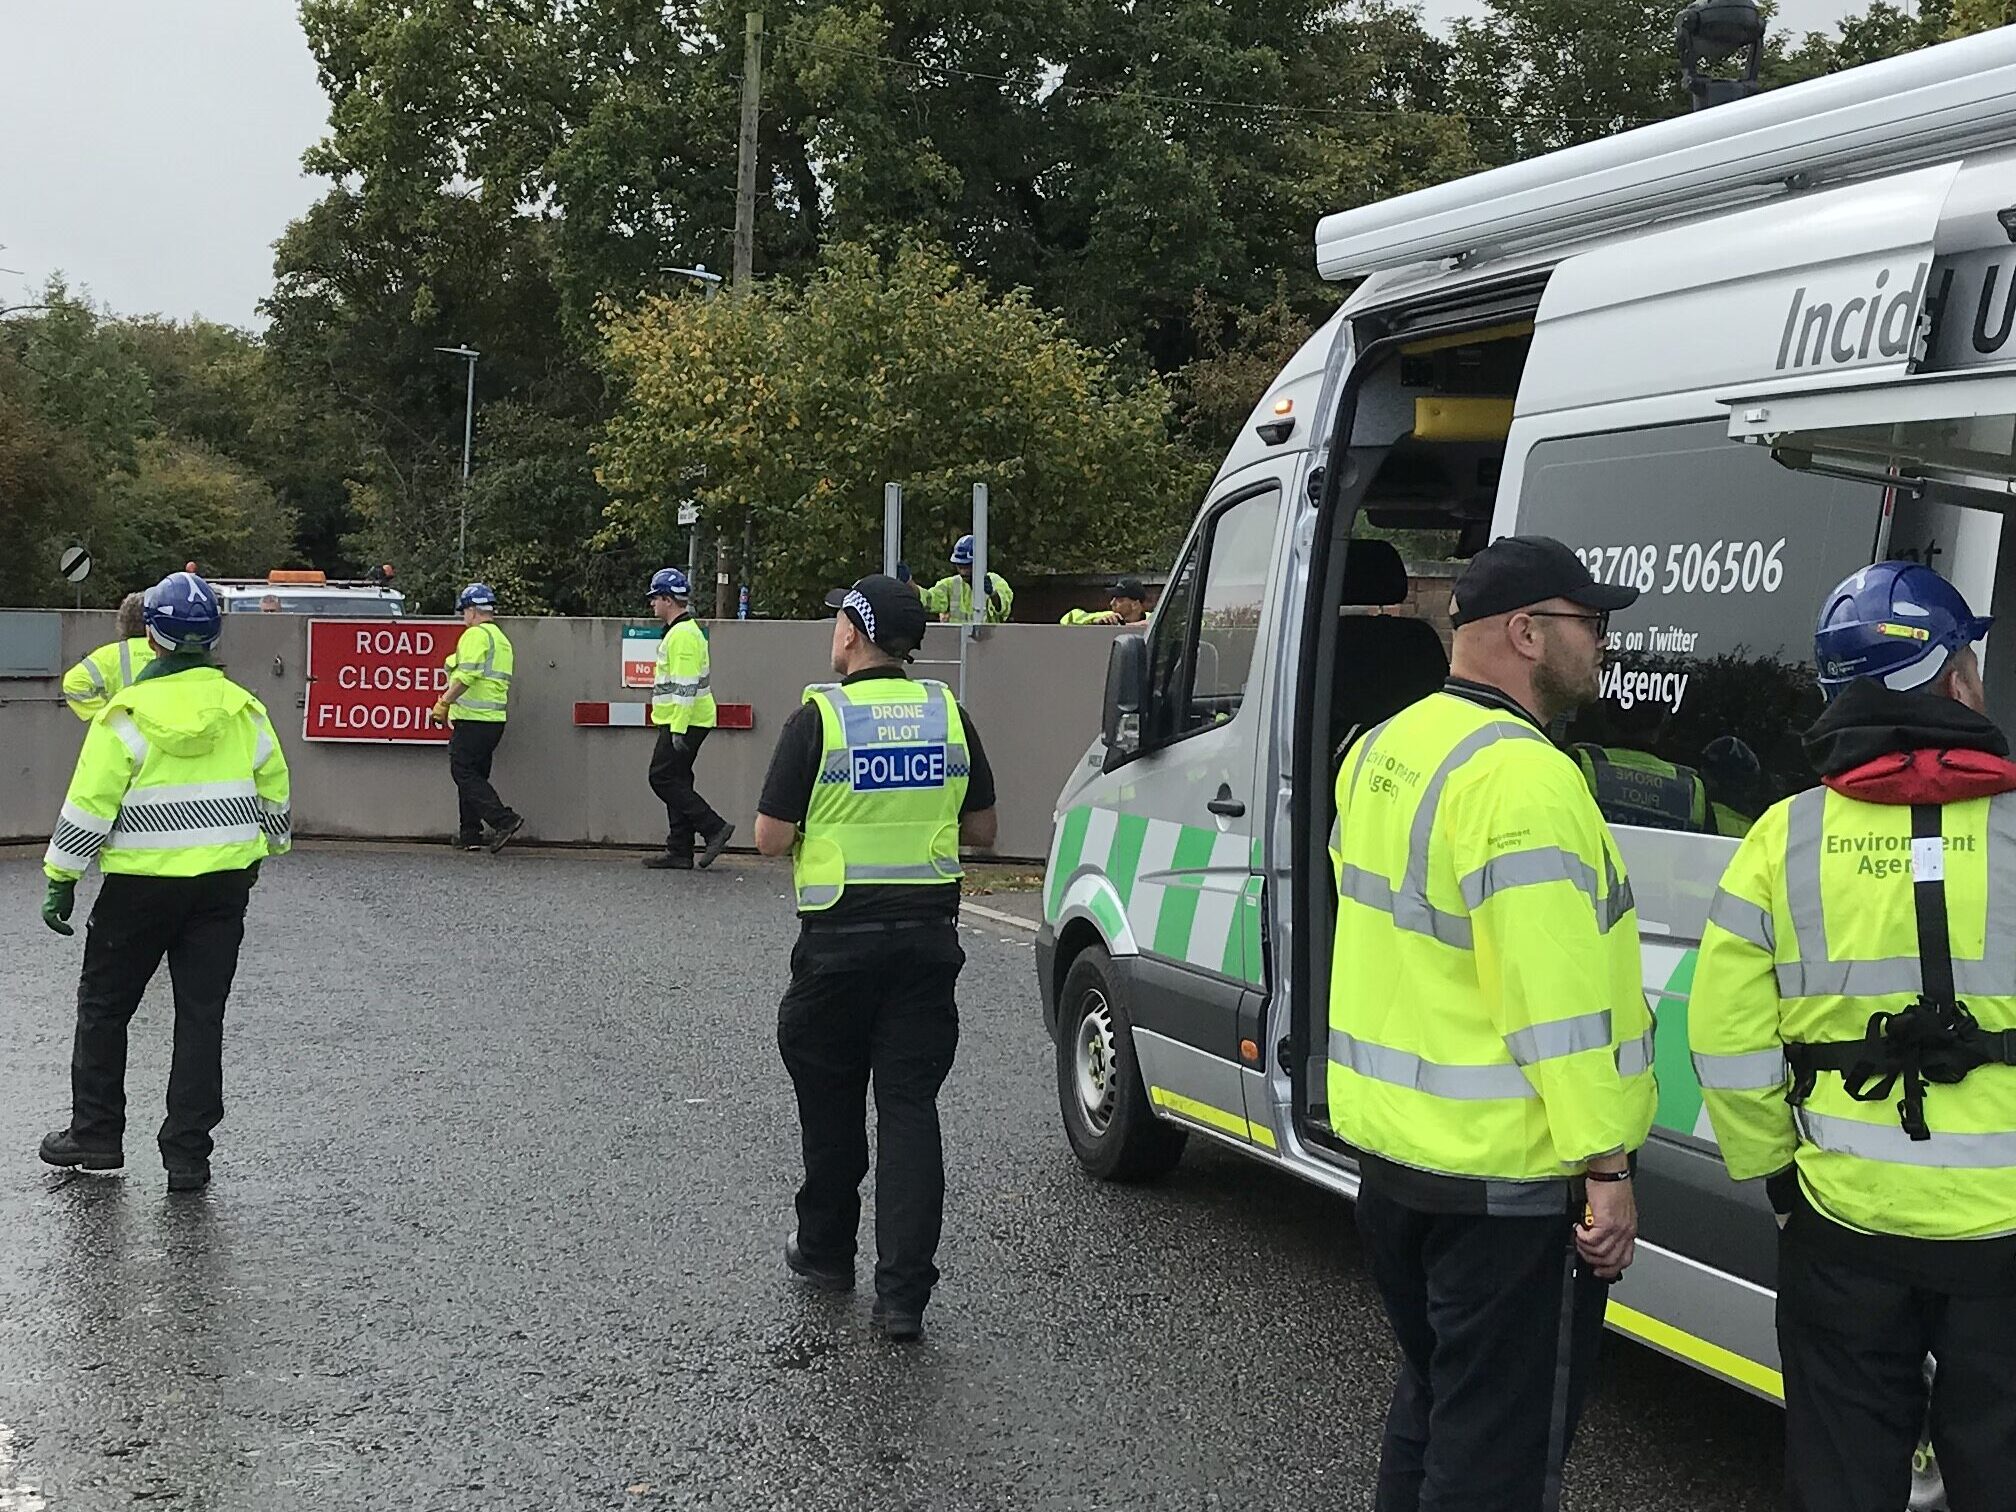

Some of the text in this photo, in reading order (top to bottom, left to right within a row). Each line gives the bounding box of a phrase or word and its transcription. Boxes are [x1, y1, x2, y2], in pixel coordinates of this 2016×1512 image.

[1662, 537, 1786, 594] 506506
[356, 630, 434, 655] ROAD
[1626, 631, 1644, 651] on
[1648, 625, 1699, 652] Twitter
[338, 665, 450, 691] CLOSED
[635, 663, 651, 675] No
[1598, 661, 1689, 714] vAgency
[318, 704, 455, 730] FLOODIN
[871, 704, 925, 720] DRONE
[877, 725, 921, 741] PILOT
[854, 753, 944, 784] POLICE
[1827, 832, 1976, 854] Environent
